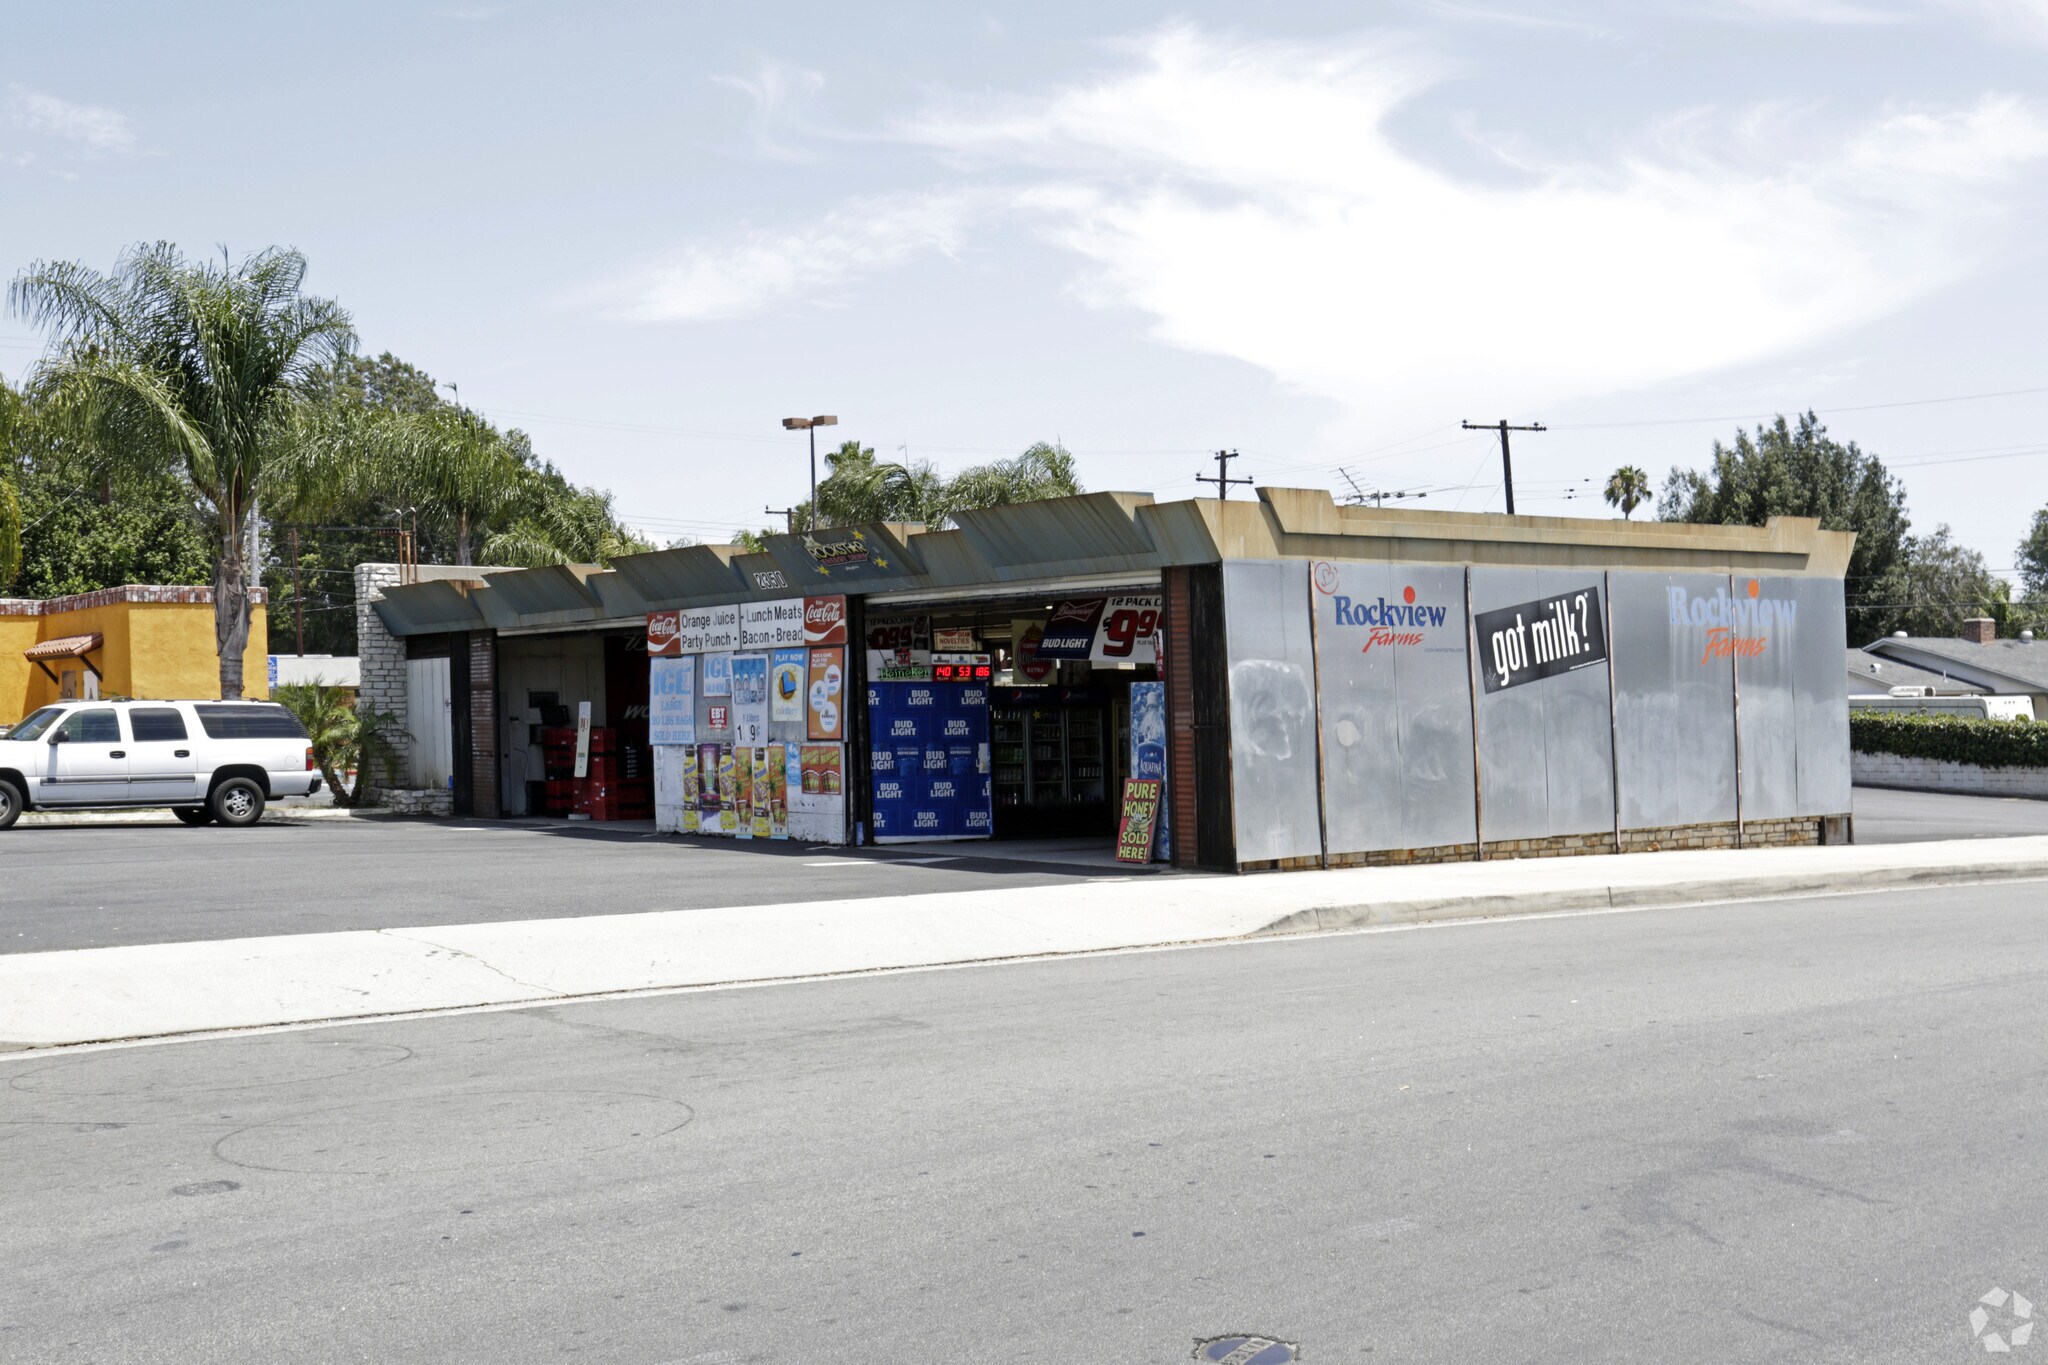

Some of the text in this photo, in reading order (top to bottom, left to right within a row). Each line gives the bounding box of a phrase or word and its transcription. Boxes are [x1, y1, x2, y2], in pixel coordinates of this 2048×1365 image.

[754, 571, 788, 589] 2350
[1111, 598, 1123, 606] 12
[1125, 597, 1152, 607] PACK
[1333, 586, 1447, 627] Rockview
[1666, 586, 1797, 627] Rockview
[746, 605, 803, 622] Lunch Meats
[806, 602, 841, 623] Coca-Cola
[1058, 604, 1094, 616] Budweiser
[682, 612, 735, 629] Orange Juice
[649, 617, 677, 635] Coca-Cola
[742, 626, 803, 645] Bacon Bread
[1362, 627, 1424, 654] Farms
[682, 632, 731, 650] Party Punch
[939, 637, 970, 645] NOVELTIES
[1042, 638, 1088, 648] BUD LIGHT
[1492, 595, 1590, 687] got milk?
[1701, 628, 1767, 666] Farms
[775, 653, 803, 662] PLAY NOW
[705, 657, 731, 678] ICE
[937, 667, 951, 677] 140
[959, 667, 970, 676] 53
[976, 667, 990, 676] 186
[654, 667, 691, 695] ICE
[908, 697, 933, 705] LIGHT
[961, 697, 986, 705] LIGHT
[711, 707, 725, 719] EBT
[894, 720, 913, 728] BUD
[948, 720, 966, 728] BUD
[891, 728, 916, 736] LIGHT
[944, 727, 969, 735] LIGHT
[872, 752, 892, 760] BUD
[926, 751, 945, 760] BUD
[871, 760, 894, 770] LIGHT
[923, 760, 947, 769] LIGHT
[880, 783, 899, 791] BUD
[934, 782, 952, 790] BUD
[877, 790, 903, 799] LIGHT
[930, 789, 955, 797] LIGHT
[1126, 783, 1157, 800] PURE
[1124, 801, 1155, 818] HONEY
[917, 812, 936, 820] BUD
[969, 812, 988, 820] BUD
[914, 820, 939, 828] LIGHT
[966, 819, 990, 827] LIGHT
[1122, 831, 1149, 845] SOLD
[1119, 847, 1148, 860] HERE!
